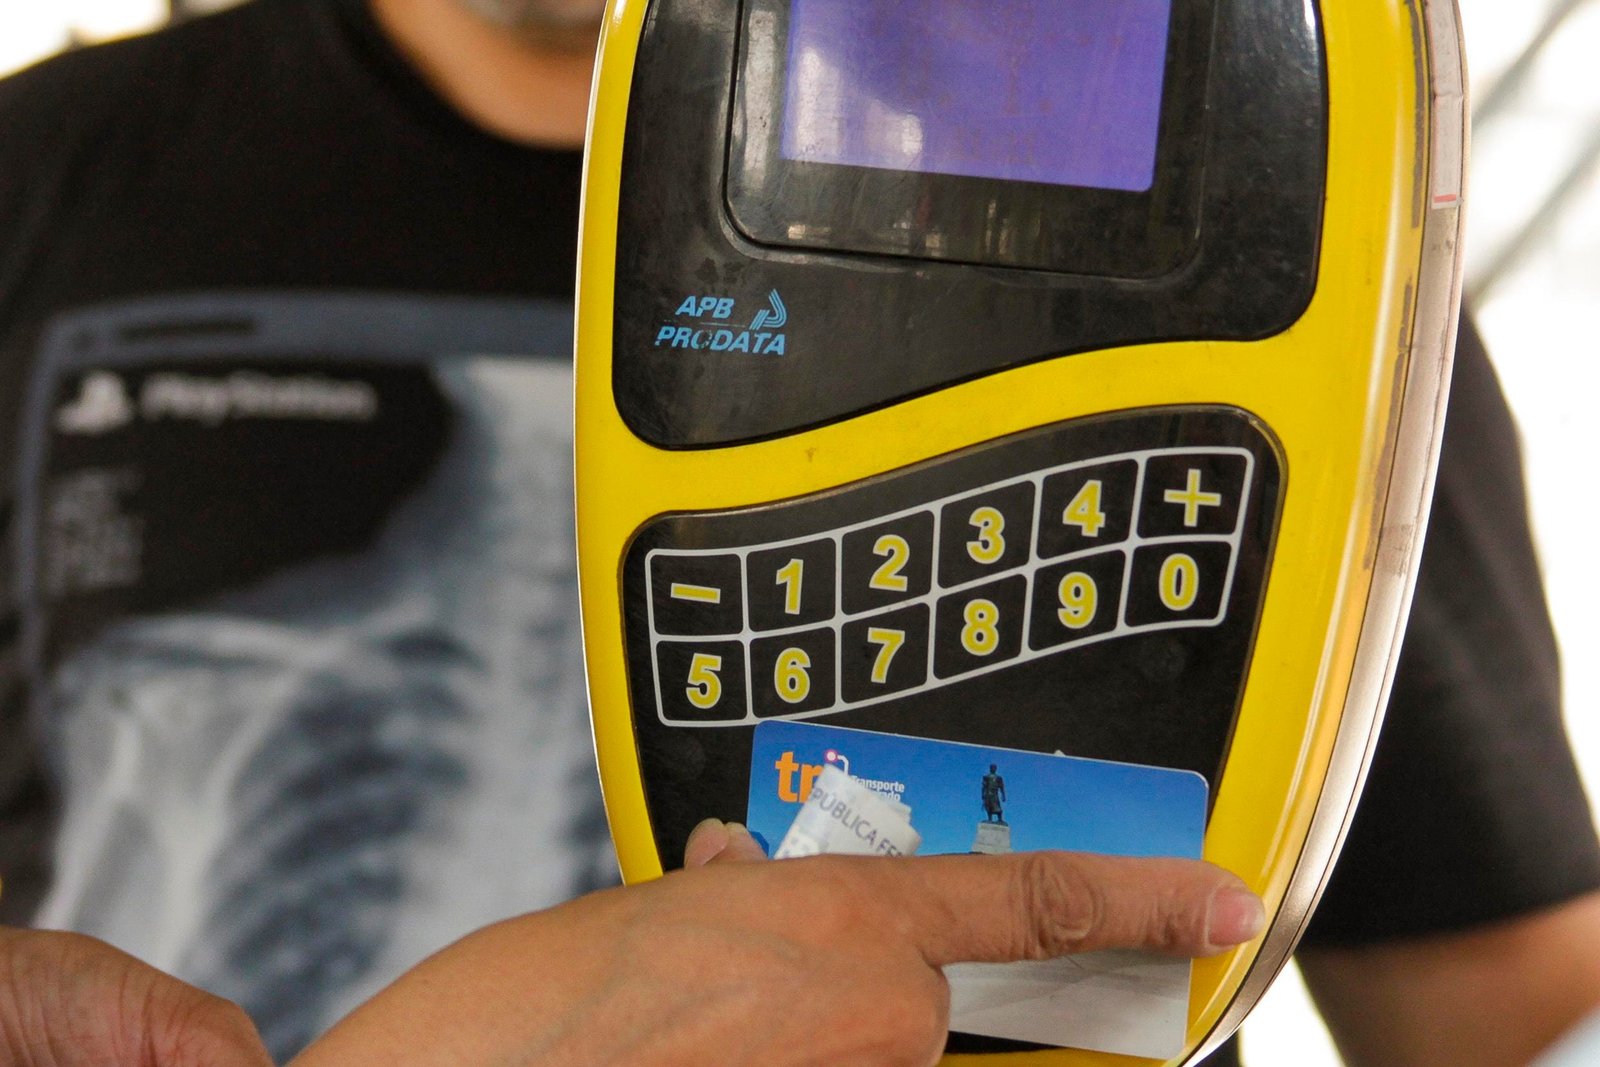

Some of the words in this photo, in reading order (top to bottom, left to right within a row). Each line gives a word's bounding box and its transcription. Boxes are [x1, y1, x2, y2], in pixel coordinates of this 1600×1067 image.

[675, 295, 735, 319] APB
[654, 325, 786, 356] PRODATA
[775, 558, 804, 615] 1
[869, 534, 910, 592] 2
[966, 506, 1006, 565] 3
[1062, 479, 1106, 538] 4
[686, 652, 722, 709] 5
[774, 647, 812, 704] 6
[867, 627, 906, 684] 7
[960, 598, 1000, 657] 8
[1057, 571, 1098, 629] 9
[1158, 553, 1199, 611] 0
[851, 775, 905, 793] ansporte
